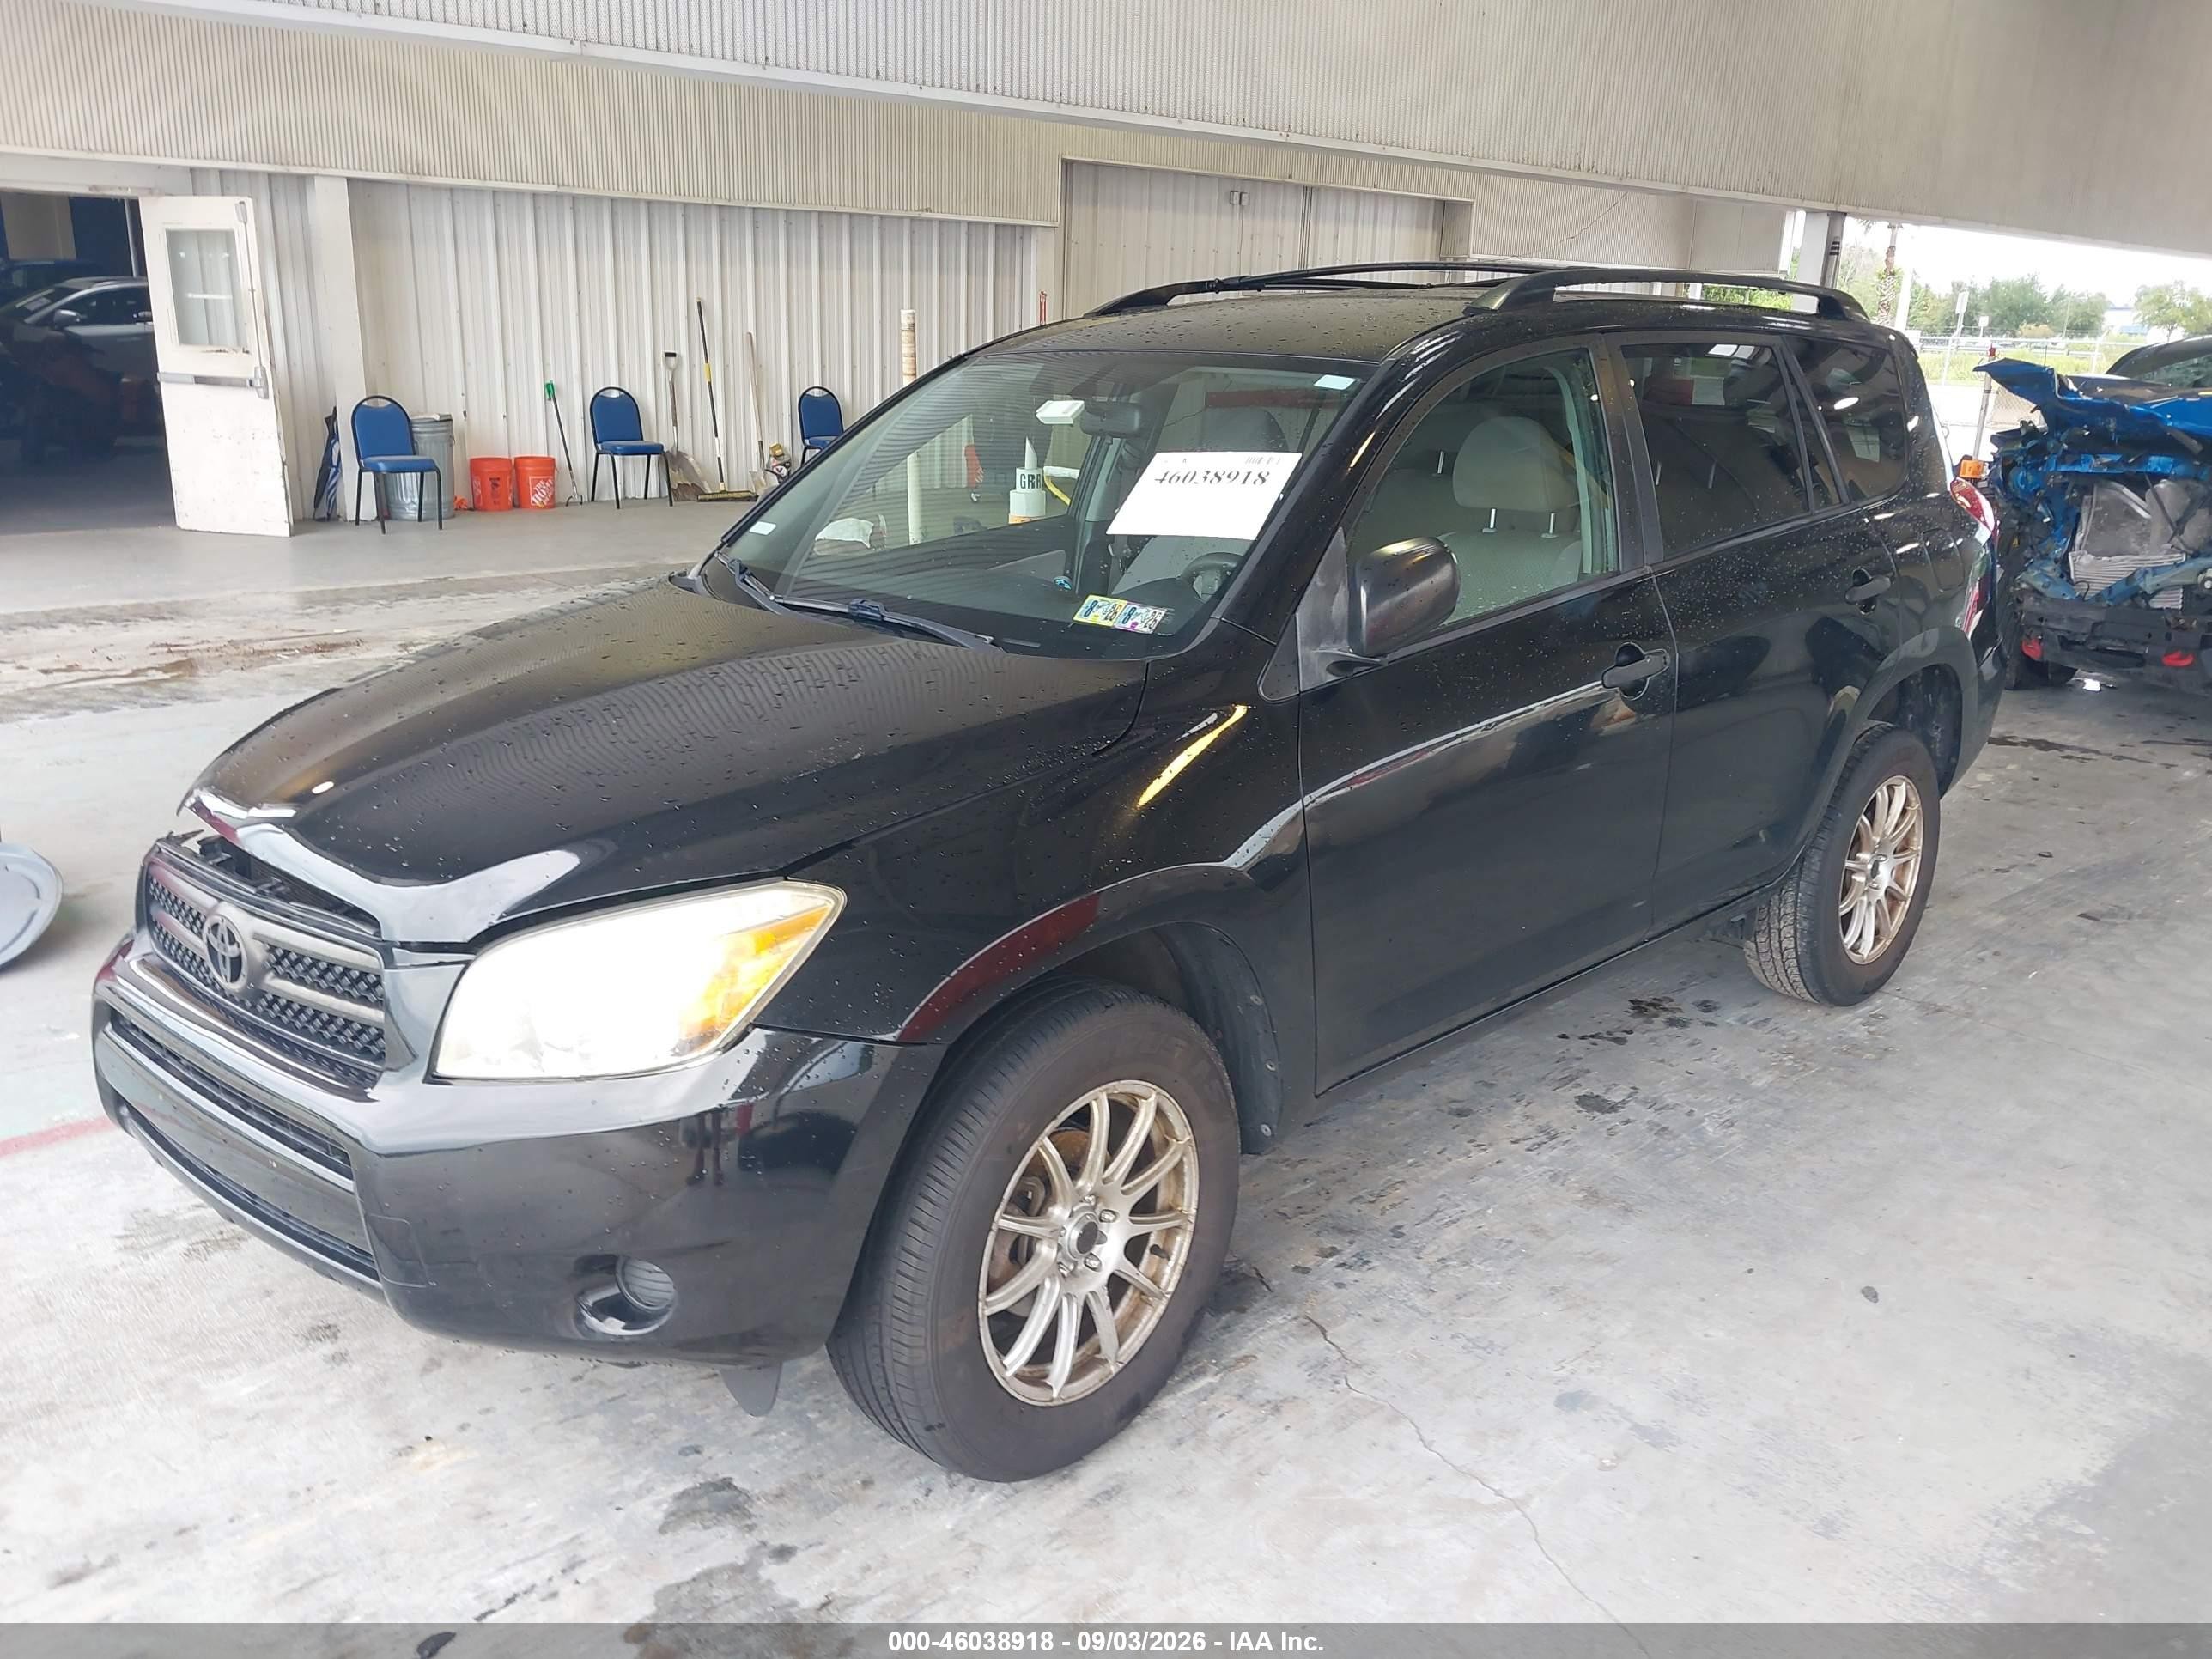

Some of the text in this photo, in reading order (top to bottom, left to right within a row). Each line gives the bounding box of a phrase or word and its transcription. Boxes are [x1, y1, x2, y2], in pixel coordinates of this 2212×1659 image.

[1155, 470, 1271, 485] 46038918
[1084, 599, 1098, 617] 8
[1121, 606, 1137, 624] 8
